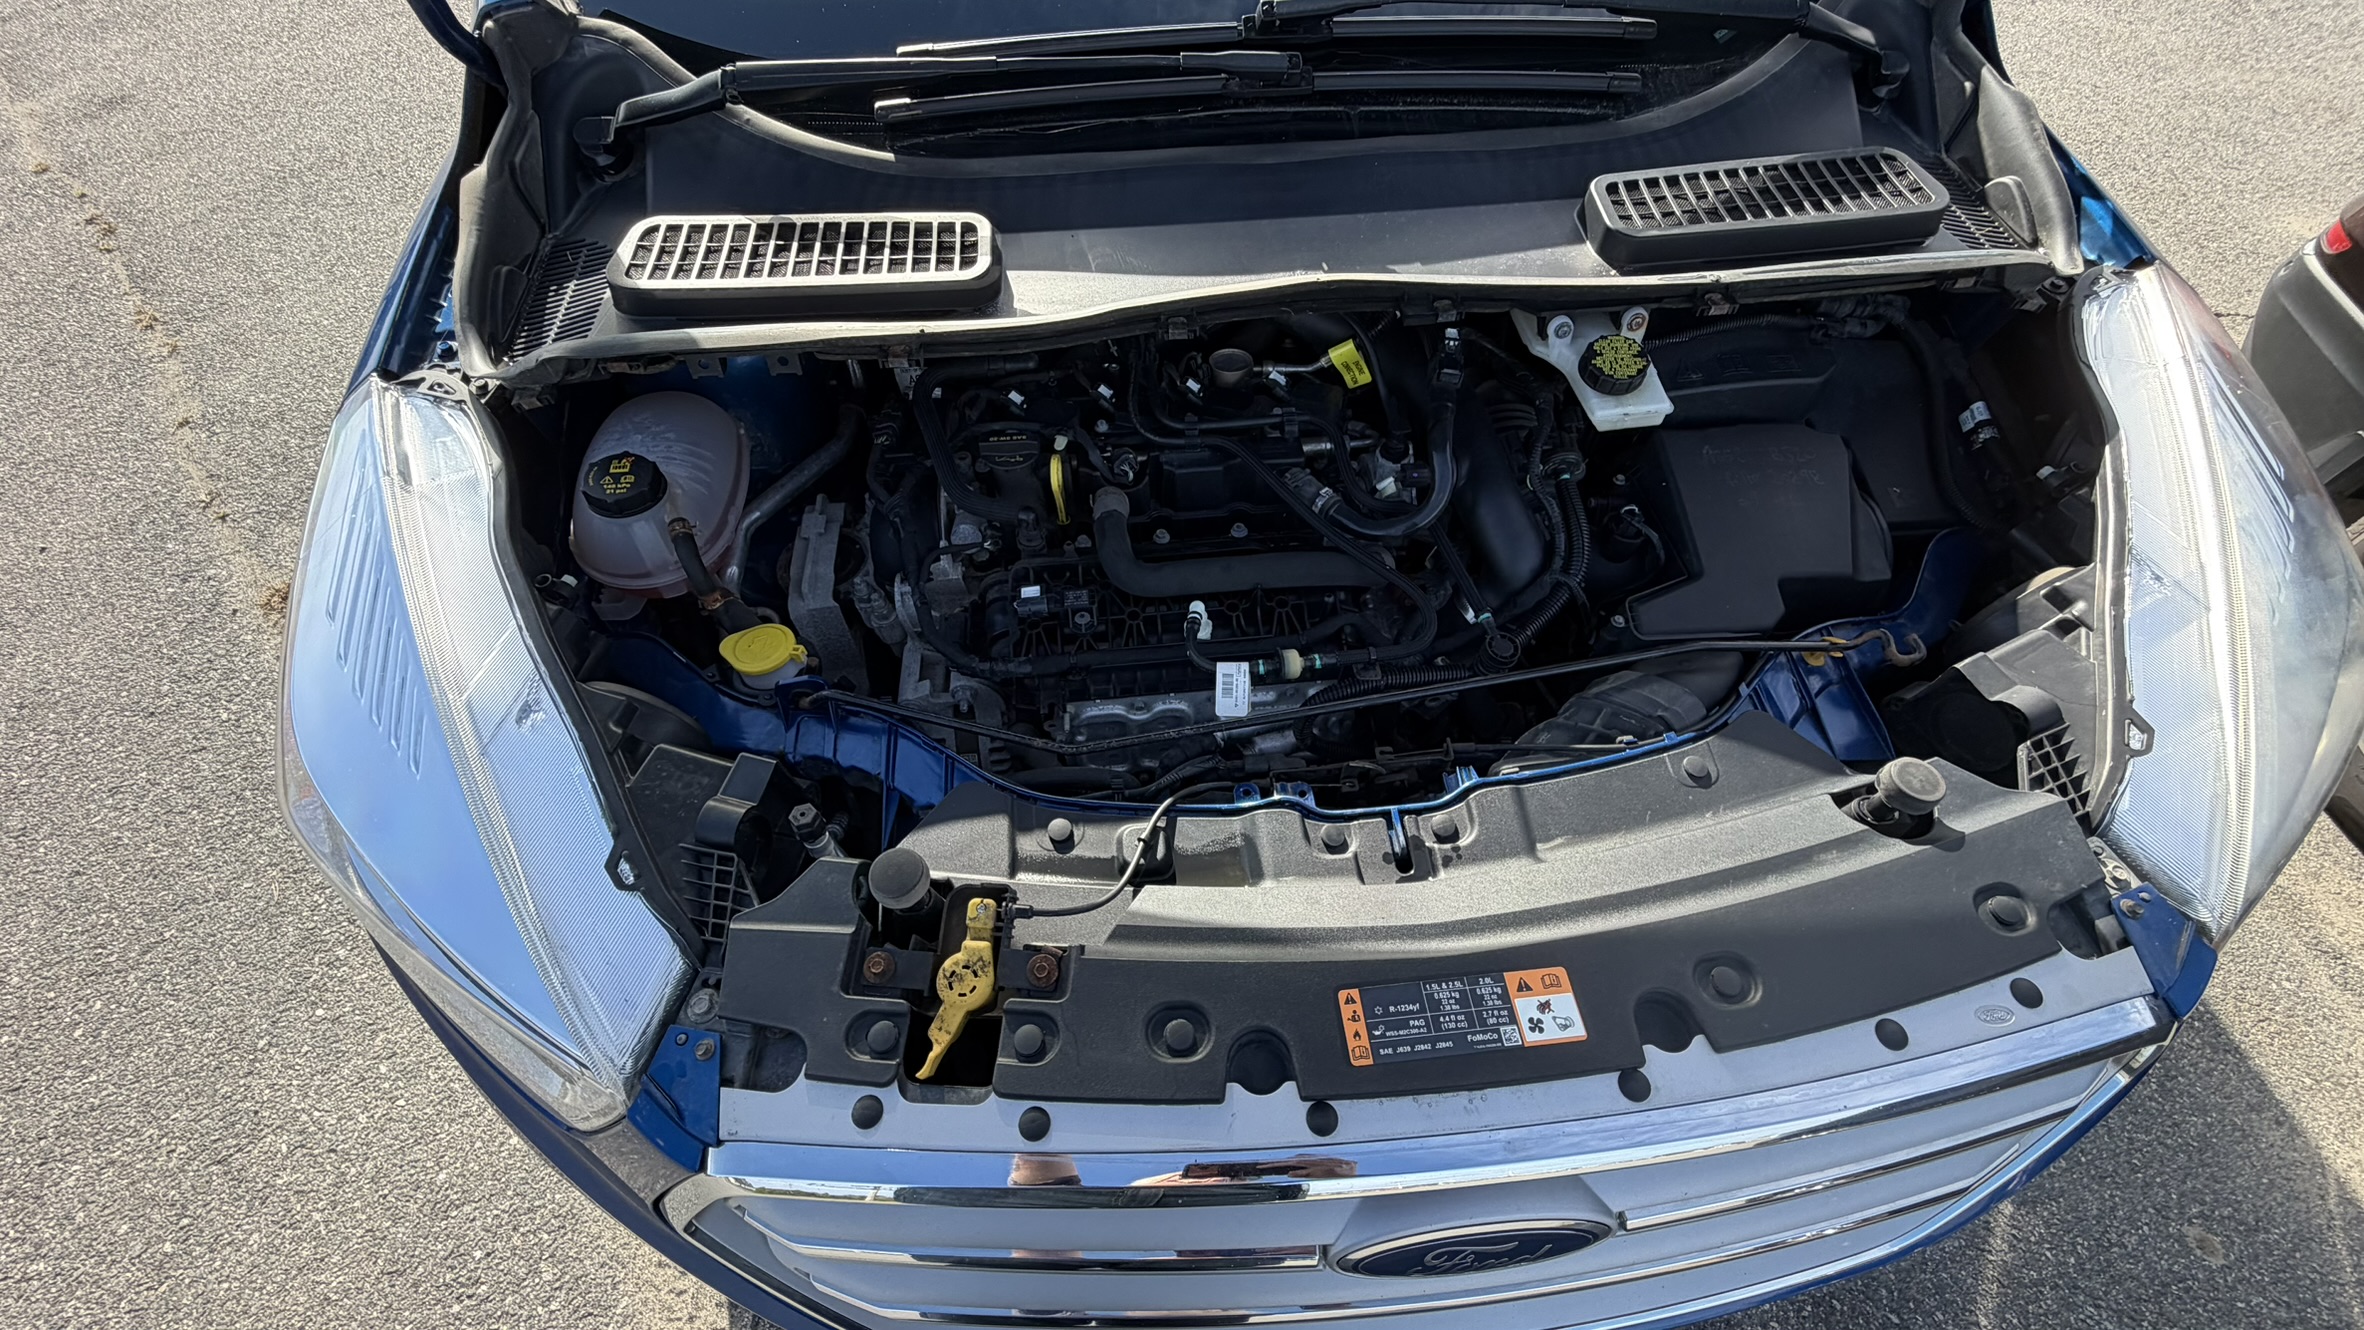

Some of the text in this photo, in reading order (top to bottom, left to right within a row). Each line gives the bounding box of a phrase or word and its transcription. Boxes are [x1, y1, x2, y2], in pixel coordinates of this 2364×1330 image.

[1426, 983, 1440, 991] 1.5L
[1448, 980, 1463, 988] 2.5L
[1478, 977, 1494, 985] 2.0L
[1476, 986, 1502, 995] 0.625 kg
[1389, 1003, 1420, 1013] R-1234yf
[1409, 1019, 1426, 1027] PAG
[1441, 1022, 1456, 1030] (130
[1486, 1018, 1497, 1026] (80
[1467, 1032, 1498, 1042] FoMoCo
[1379, 1041, 1454, 1055] SAE J639 J2842 J2845
[1406, 1242, 1553, 1276] Ford
